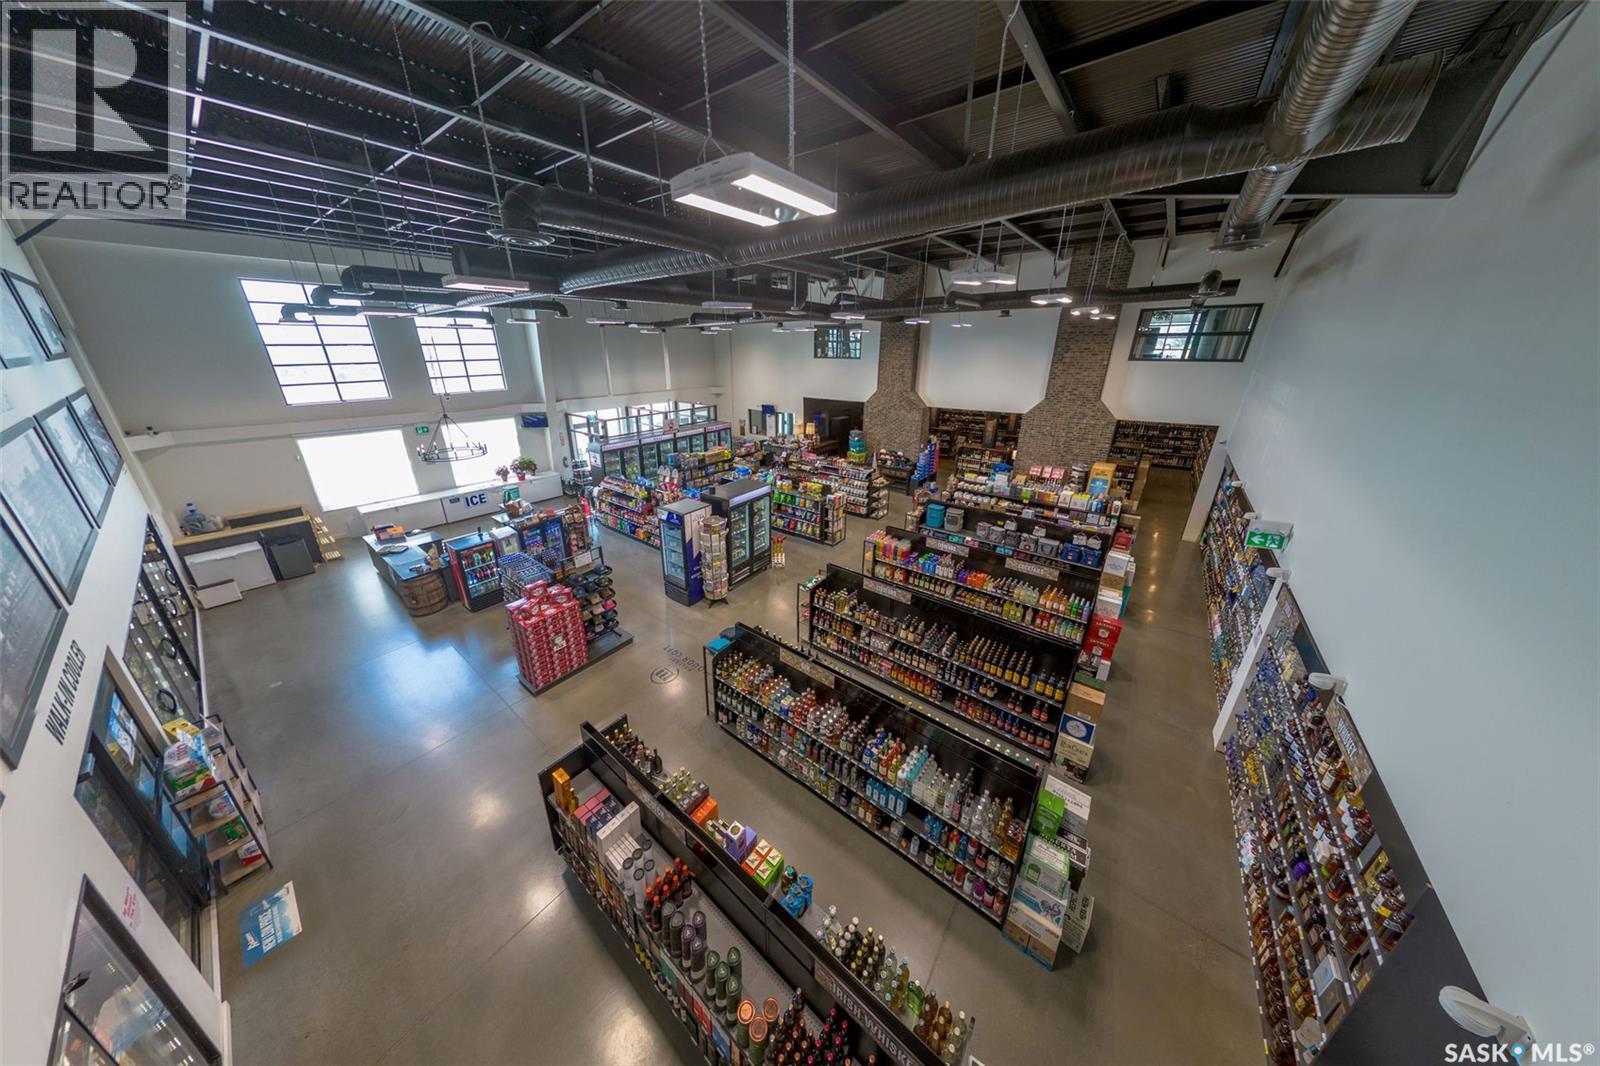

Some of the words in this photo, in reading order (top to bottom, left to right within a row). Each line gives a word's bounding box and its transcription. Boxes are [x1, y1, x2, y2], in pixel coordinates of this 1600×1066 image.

[464, 493, 488, 507] ICE
[45, 676, 75, 746] WALK-IN
[62, 639, 87, 692] COOLER
[831, 982, 861, 1020] IRISH
